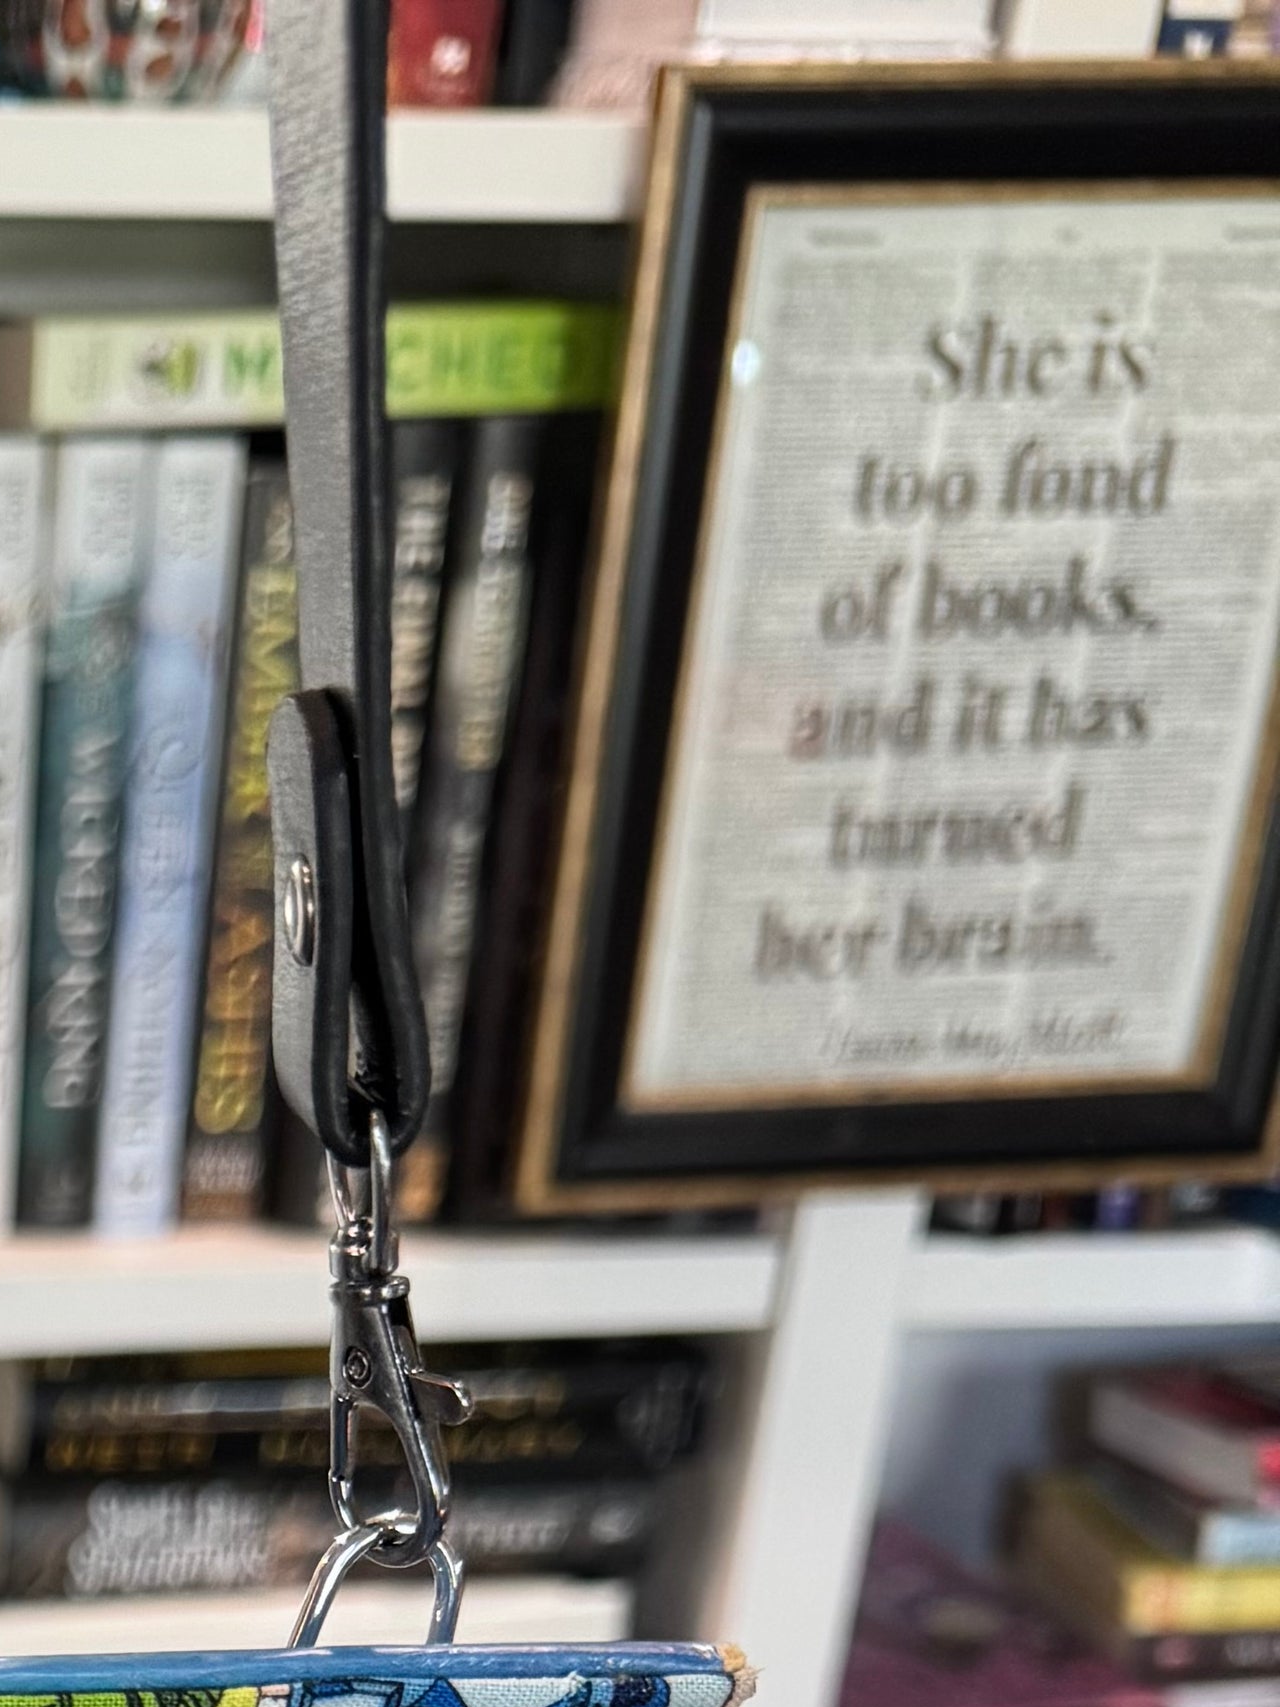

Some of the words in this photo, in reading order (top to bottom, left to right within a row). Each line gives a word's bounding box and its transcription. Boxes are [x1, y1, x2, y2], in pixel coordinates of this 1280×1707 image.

[918, 312, 1067, 402] She
[1085, 308, 1157, 395] is
[854, 450, 976, 526] too
[996, 430, 1177, 518] fond
[817, 556, 906, 645] of
[787, 670, 936, 762] and
[954, 672, 1014, 754] it
[1025, 668, 1158, 752] has
[826, 780, 1088, 870] turned
